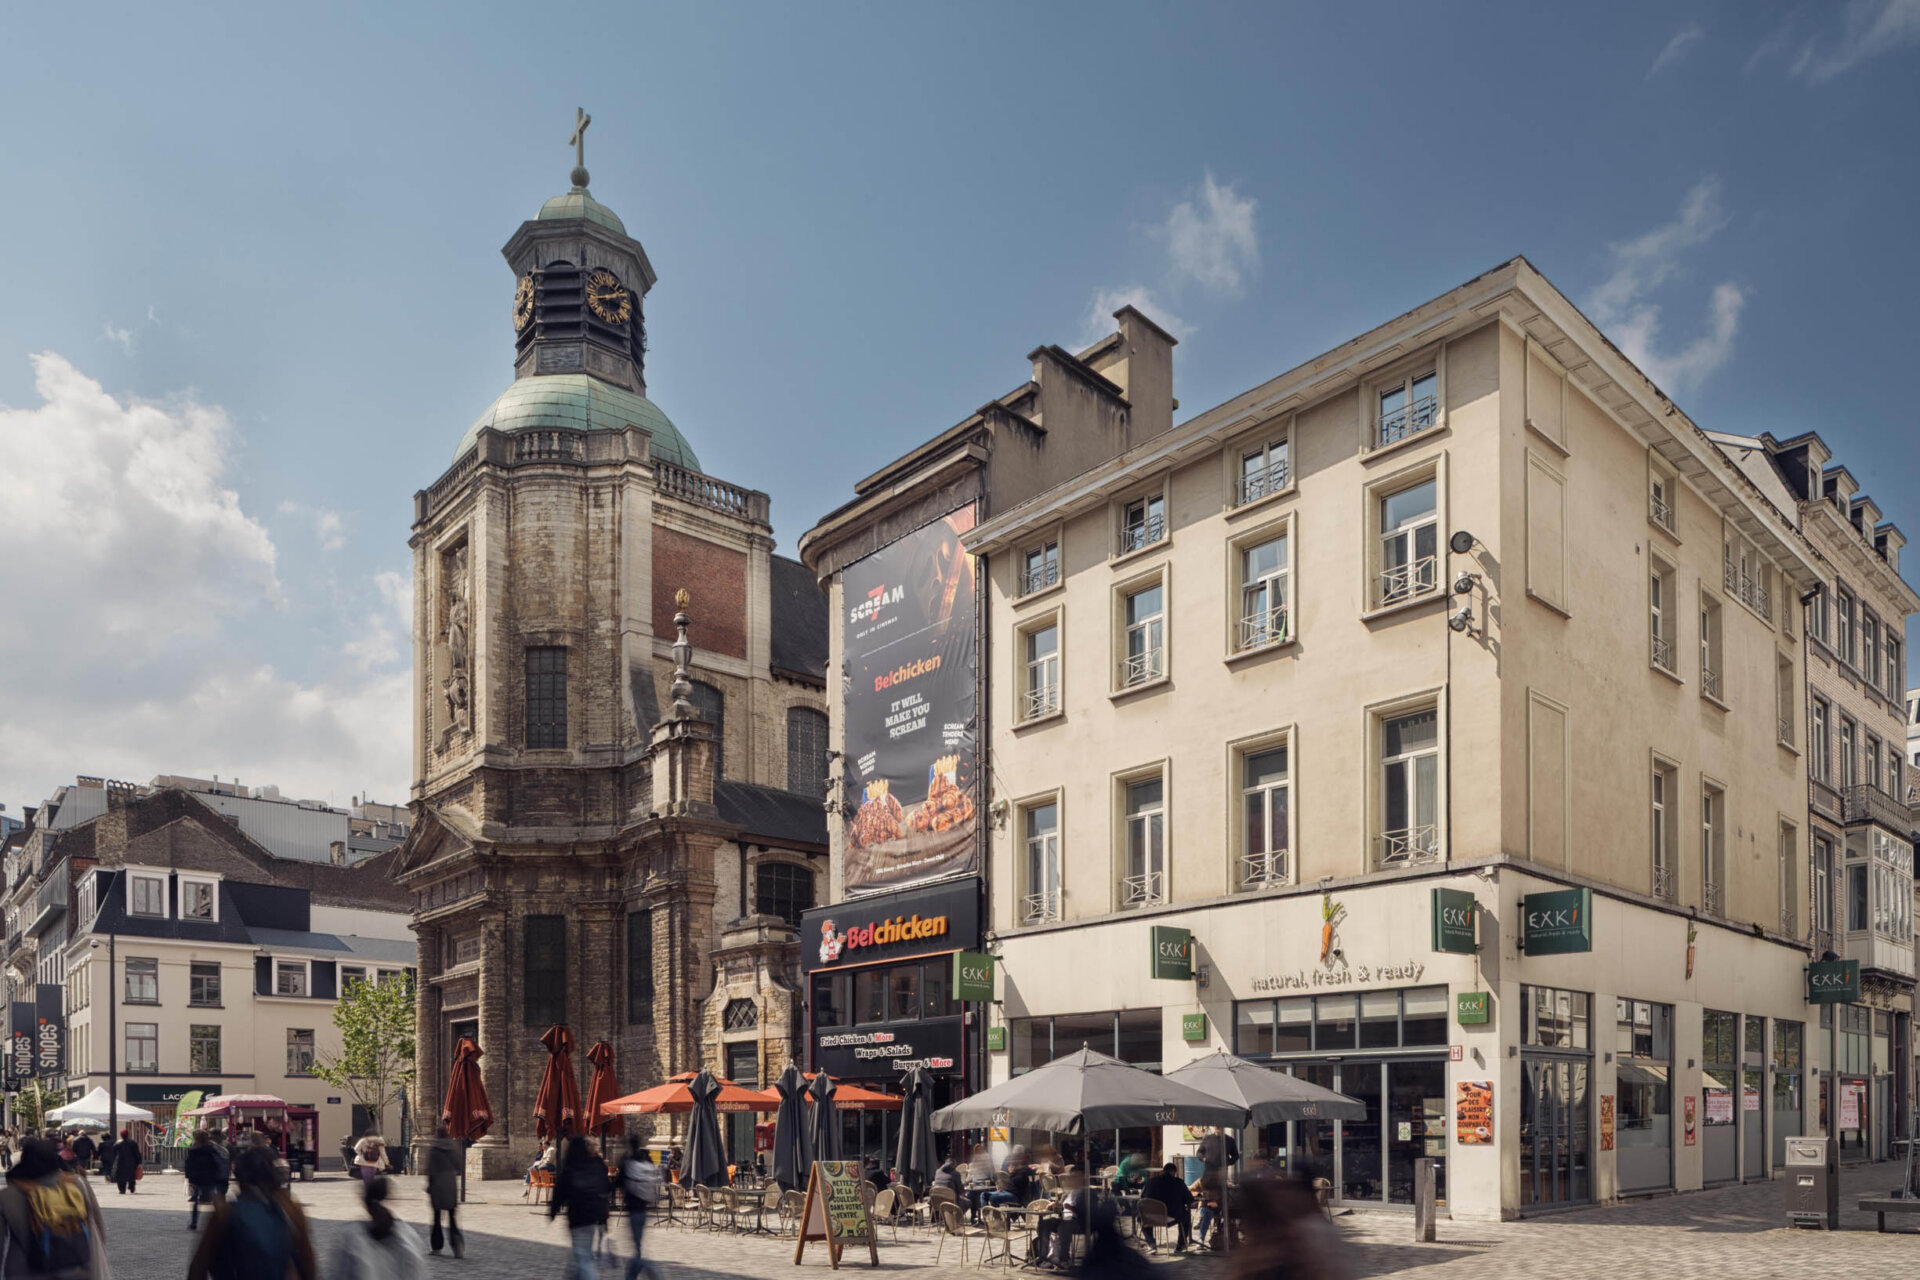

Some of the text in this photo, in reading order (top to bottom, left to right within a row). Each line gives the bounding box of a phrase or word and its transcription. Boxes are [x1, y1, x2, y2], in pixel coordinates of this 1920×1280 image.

[850, 584, 904, 624] SCREAM
[874, 655, 942, 693] Belchicken
[884, 702, 931, 728] MAKE YOU
[891, 692, 923, 713] IT WILL
[889, 717, 927, 739] SCREAM
[847, 914, 947, 949] Belchicken
[1251, 960, 1425, 993] natural, fresh & ready
[39, 1024, 61, 1068] snipes
[820, 1033, 894, 1047] Fried Chicken & More
[855, 1045, 912, 1059] Wraps & Salads
[15, 1036, 34, 1075] snipes
[893, 1057, 952, 1071] Burges & More
